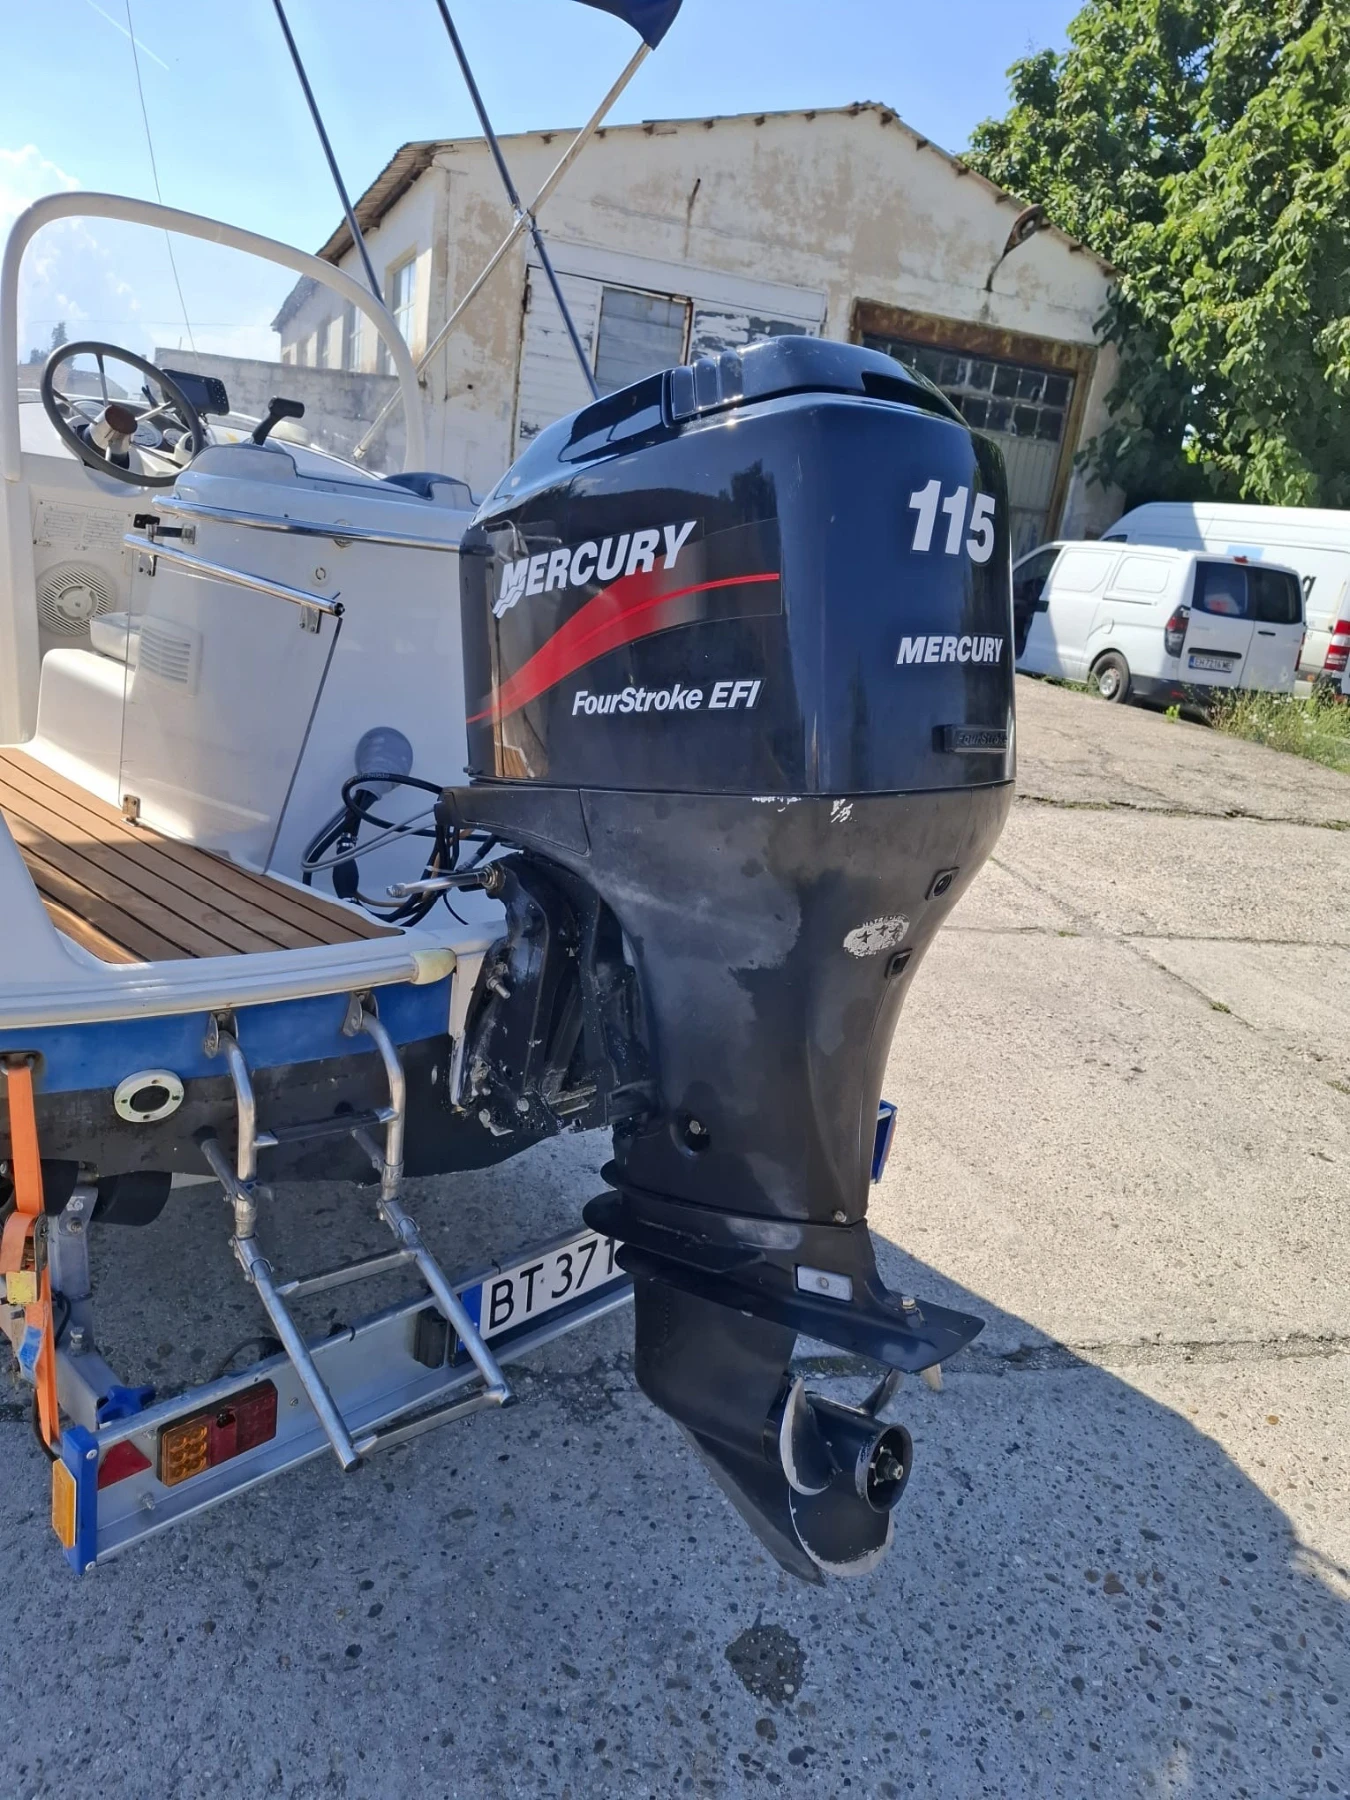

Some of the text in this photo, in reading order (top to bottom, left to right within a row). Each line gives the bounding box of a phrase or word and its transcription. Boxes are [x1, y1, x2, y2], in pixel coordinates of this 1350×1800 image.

[909, 479, 996, 564] 115
[492, 520, 697, 619] MERCURY
[896, 635, 1003, 665] MERCURY
[571, 680, 762, 716] FourStroke EFI
[489, 1262, 544, 1331] BT
